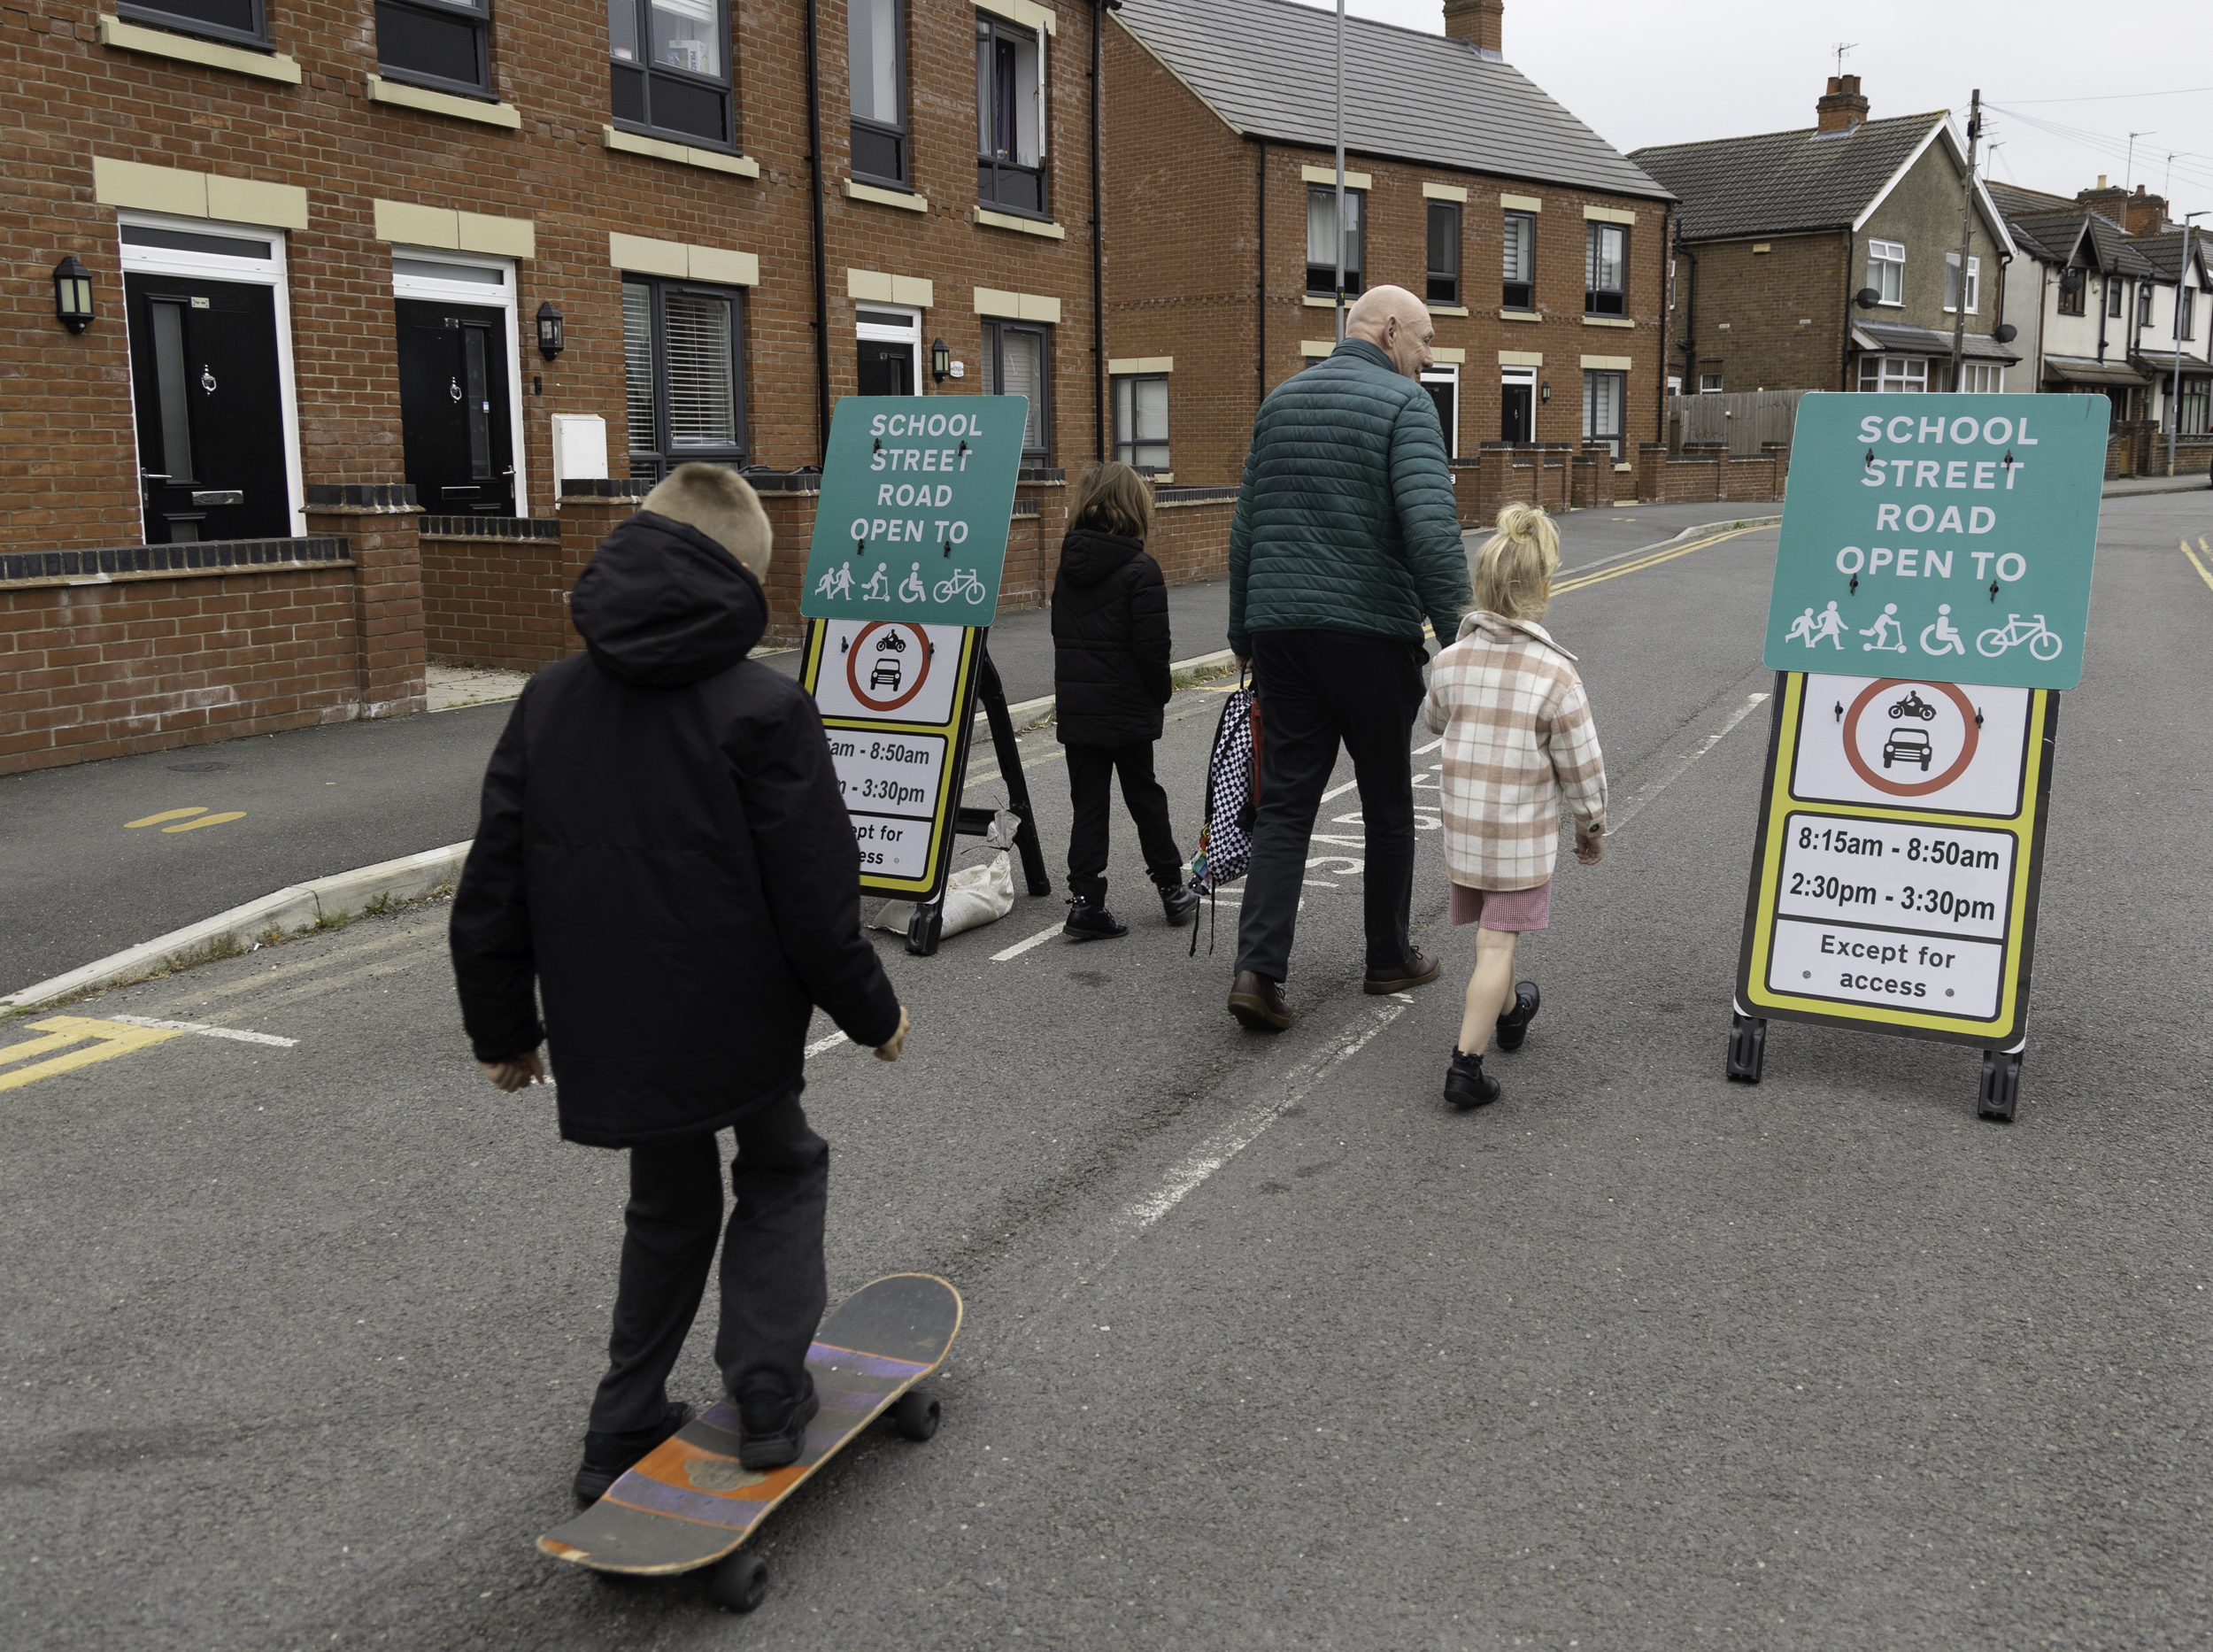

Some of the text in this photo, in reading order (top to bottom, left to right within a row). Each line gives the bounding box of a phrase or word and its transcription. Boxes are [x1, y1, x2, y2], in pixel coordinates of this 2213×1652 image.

[869, 413, 983, 436] SCHOOL
[1856, 415, 2039, 445] SCHOOL
[869, 448, 973, 472] STREET
[1860, 459, 2024, 490] STREET
[877, 483, 952, 507] ROAD
[850, 518, 968, 544] OPEN TO
[1876, 503, 1996, 535] ROAD
[1835, 545, 2027, 583] OPEN TO
[869, 742, 929, 765] 8:50am
[862, 778, 925, 806] 3:30pm
[852, 823, 904, 842] ept for
[860, 850, 883, 865] ess
[1799, 826, 1884, 858] 8:15am
[1907, 838, 2000, 870] 8:50am
[1789, 872, 1877, 907] 2:30pm
[1901, 885, 1995, 922] 3:30pm
[1820, 934, 1956, 969] Except for
[1839, 972, 1927, 998] access
